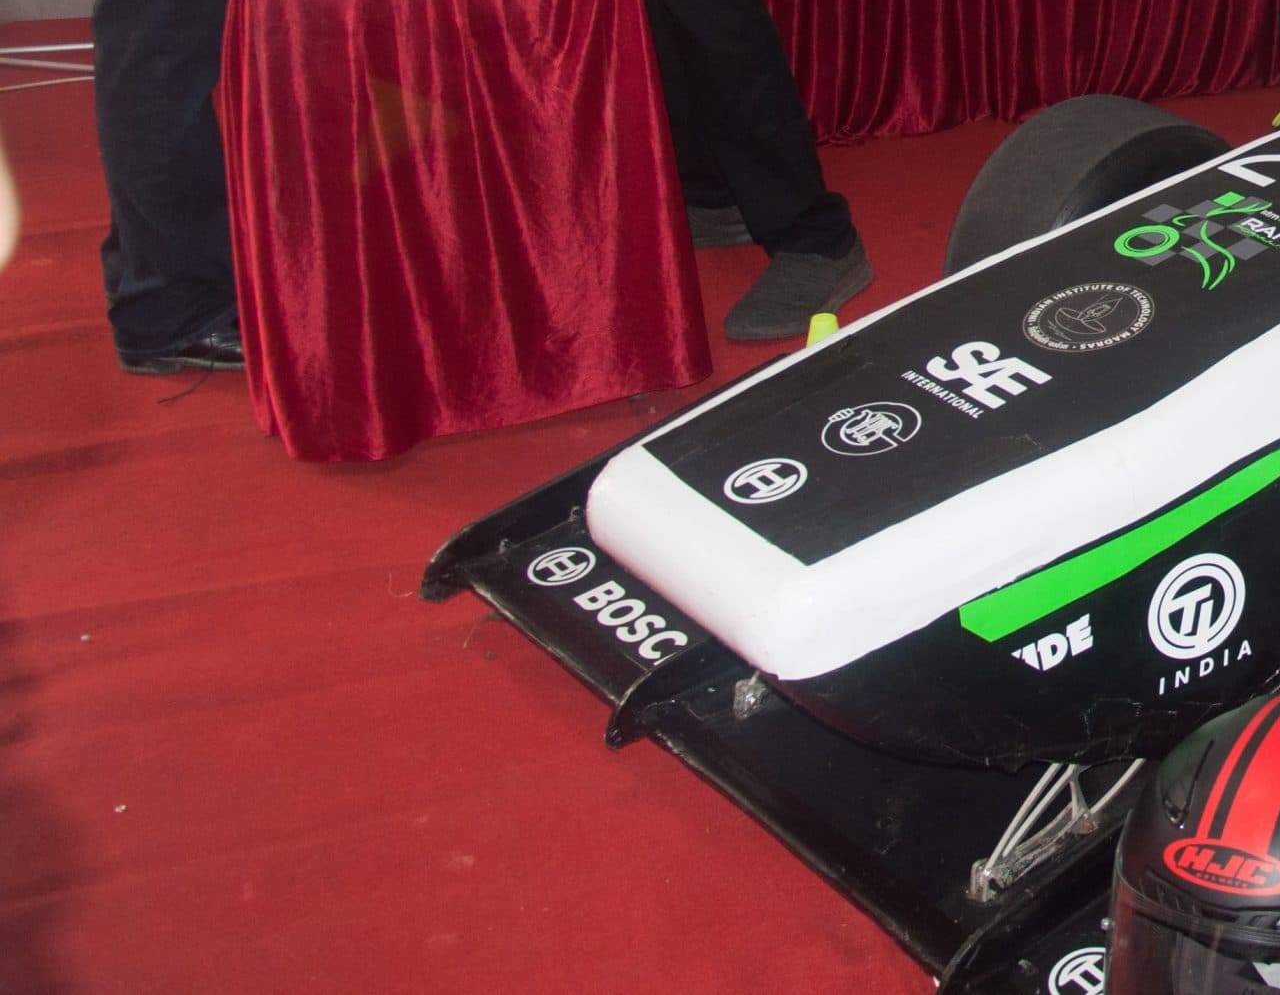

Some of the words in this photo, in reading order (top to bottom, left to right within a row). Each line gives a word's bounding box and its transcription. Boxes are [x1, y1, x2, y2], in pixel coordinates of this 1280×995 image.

[1028, 299, 1053, 323] INDIAN
[1054, 285, 1115, 301] INSTITUTE
[1116, 285, 1130, 297] OF
[1130, 290, 1151, 333] TECHNOLOGY
[1080, 331, 1131, 349] MADRAS
[901, 370, 988, 419] INTERNATIONAL
[926, 341, 1052, 409] SAE
[573, 581, 688, 666] BOSC
[1158, 641, 1254, 695] INDIA
[1178, 846, 1274, 885] HJC
